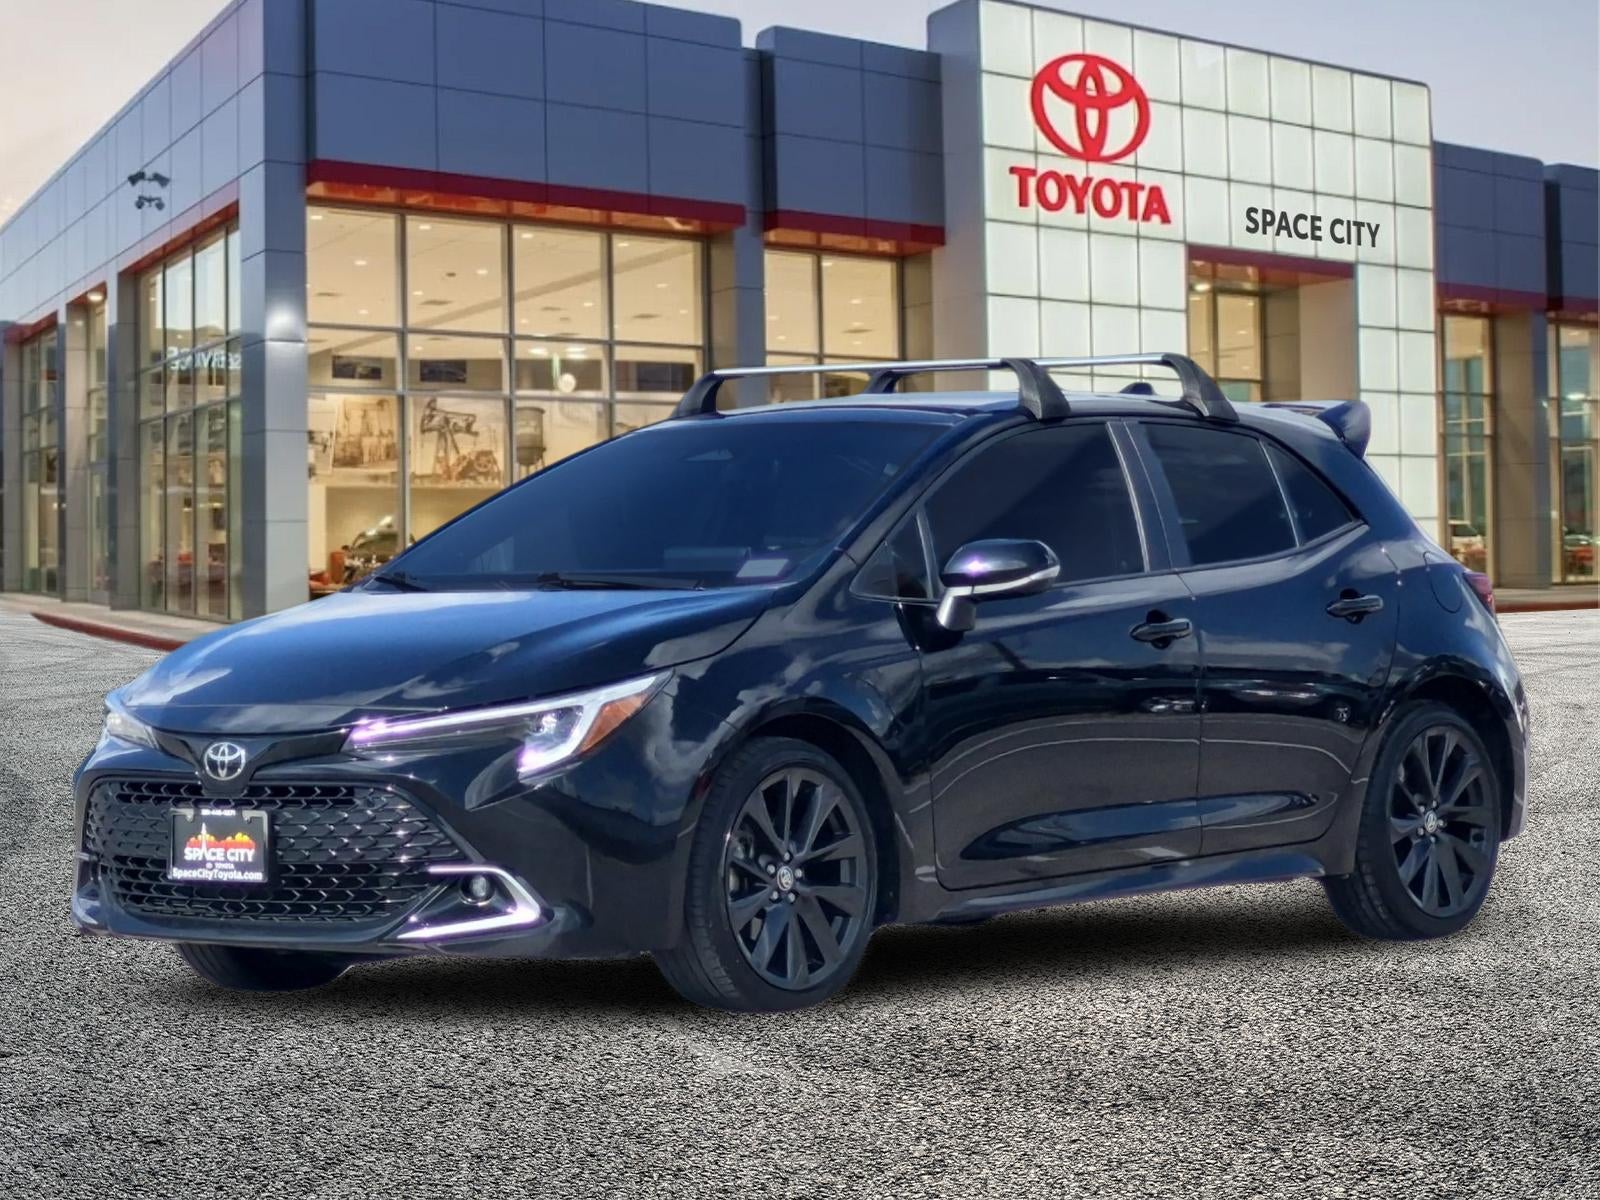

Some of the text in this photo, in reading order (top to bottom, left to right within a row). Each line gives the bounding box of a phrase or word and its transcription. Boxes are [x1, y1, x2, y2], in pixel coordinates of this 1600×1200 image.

[1009, 166, 1171, 224] TOYOTA
[1245, 206, 1380, 248] SPACE CITY
[184, 847, 255, 862] SPACE CITY
[173, 868, 263, 880] SpaceCityToyota.com
